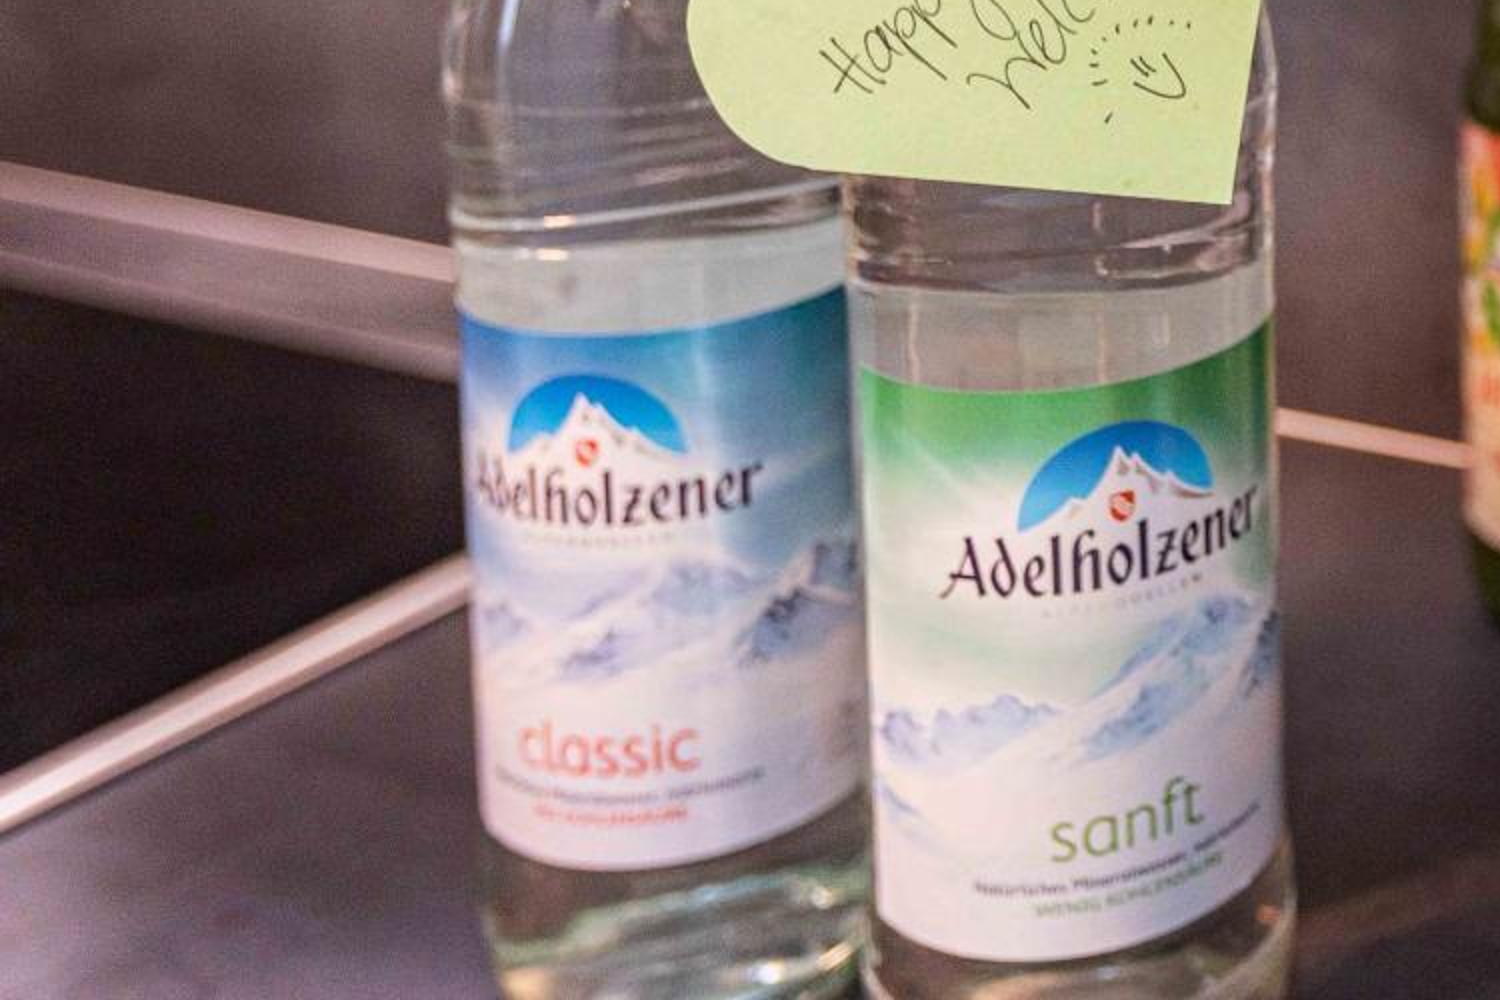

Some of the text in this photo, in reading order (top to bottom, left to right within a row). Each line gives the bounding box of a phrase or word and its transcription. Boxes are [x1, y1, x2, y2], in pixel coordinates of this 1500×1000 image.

[478, 451, 764, 526] Adelholzener
[939, 484, 1258, 601] Adelholzener
[517, 718, 704, 778] classic
[1049, 774, 1206, 864] sanft
